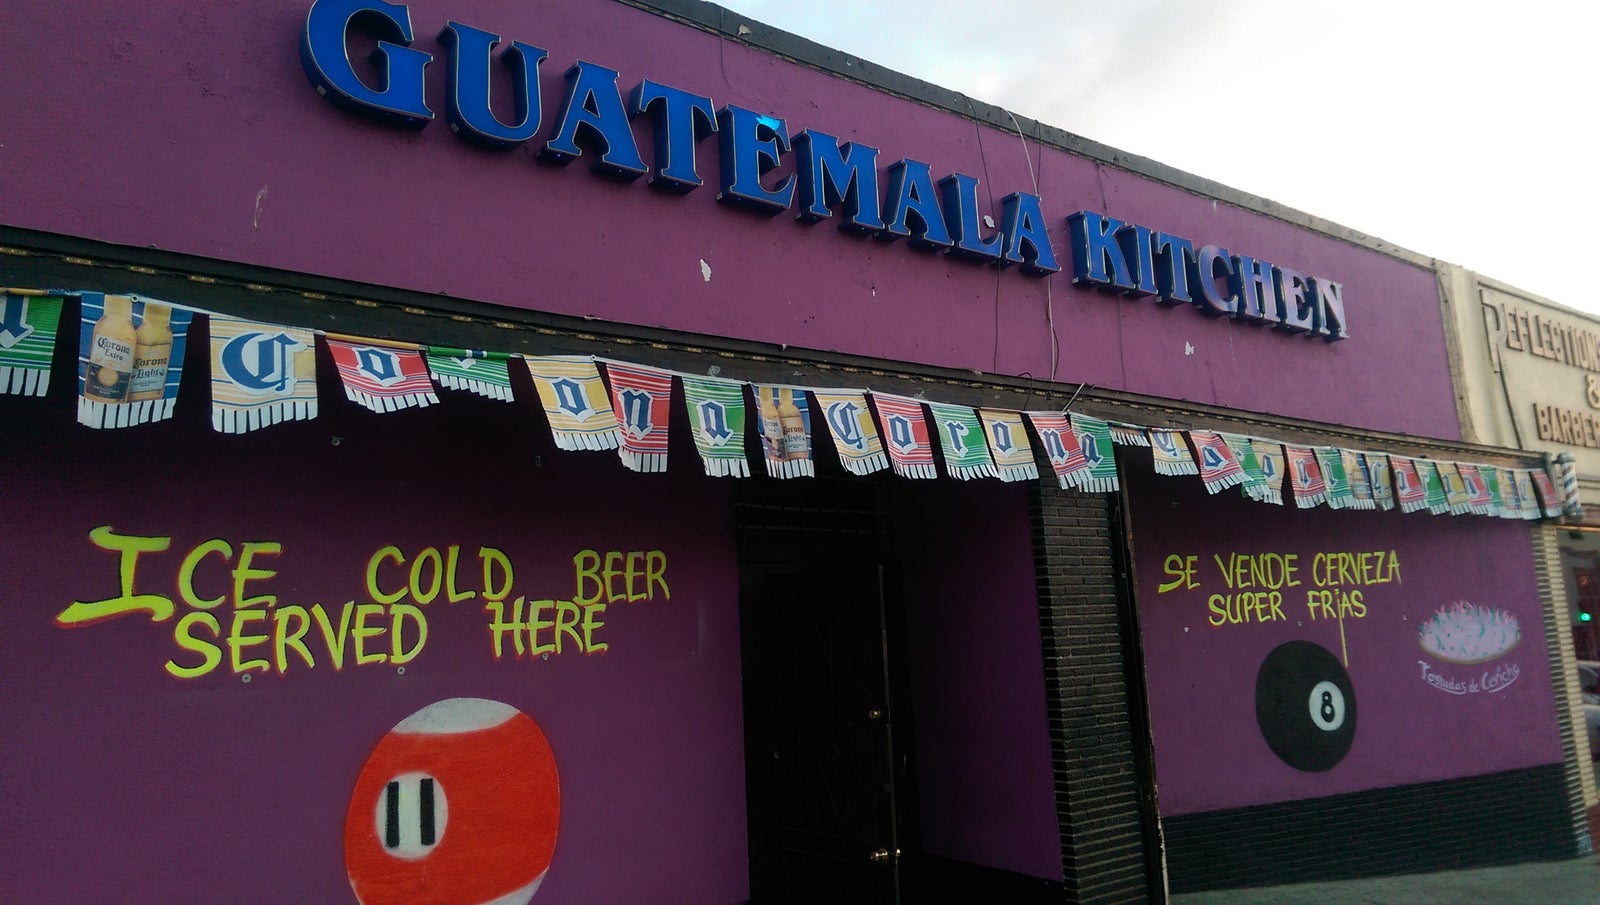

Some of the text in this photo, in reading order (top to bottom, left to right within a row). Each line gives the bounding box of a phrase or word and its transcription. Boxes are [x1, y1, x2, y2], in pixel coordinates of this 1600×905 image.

[302, 0, 1350, 342] GUATEMALA KITCHEN
[97, 336, 130, 354] Corona
[55, 526, 671, 624] ICE COLD BEER
[1157, 549, 1402, 594] SE VENDE CERVEZA
[1208, 590, 1287, 627] SUPER
[164, 599, 609, 679] SERVED HERE
[1321, 691, 1336, 723] 8
